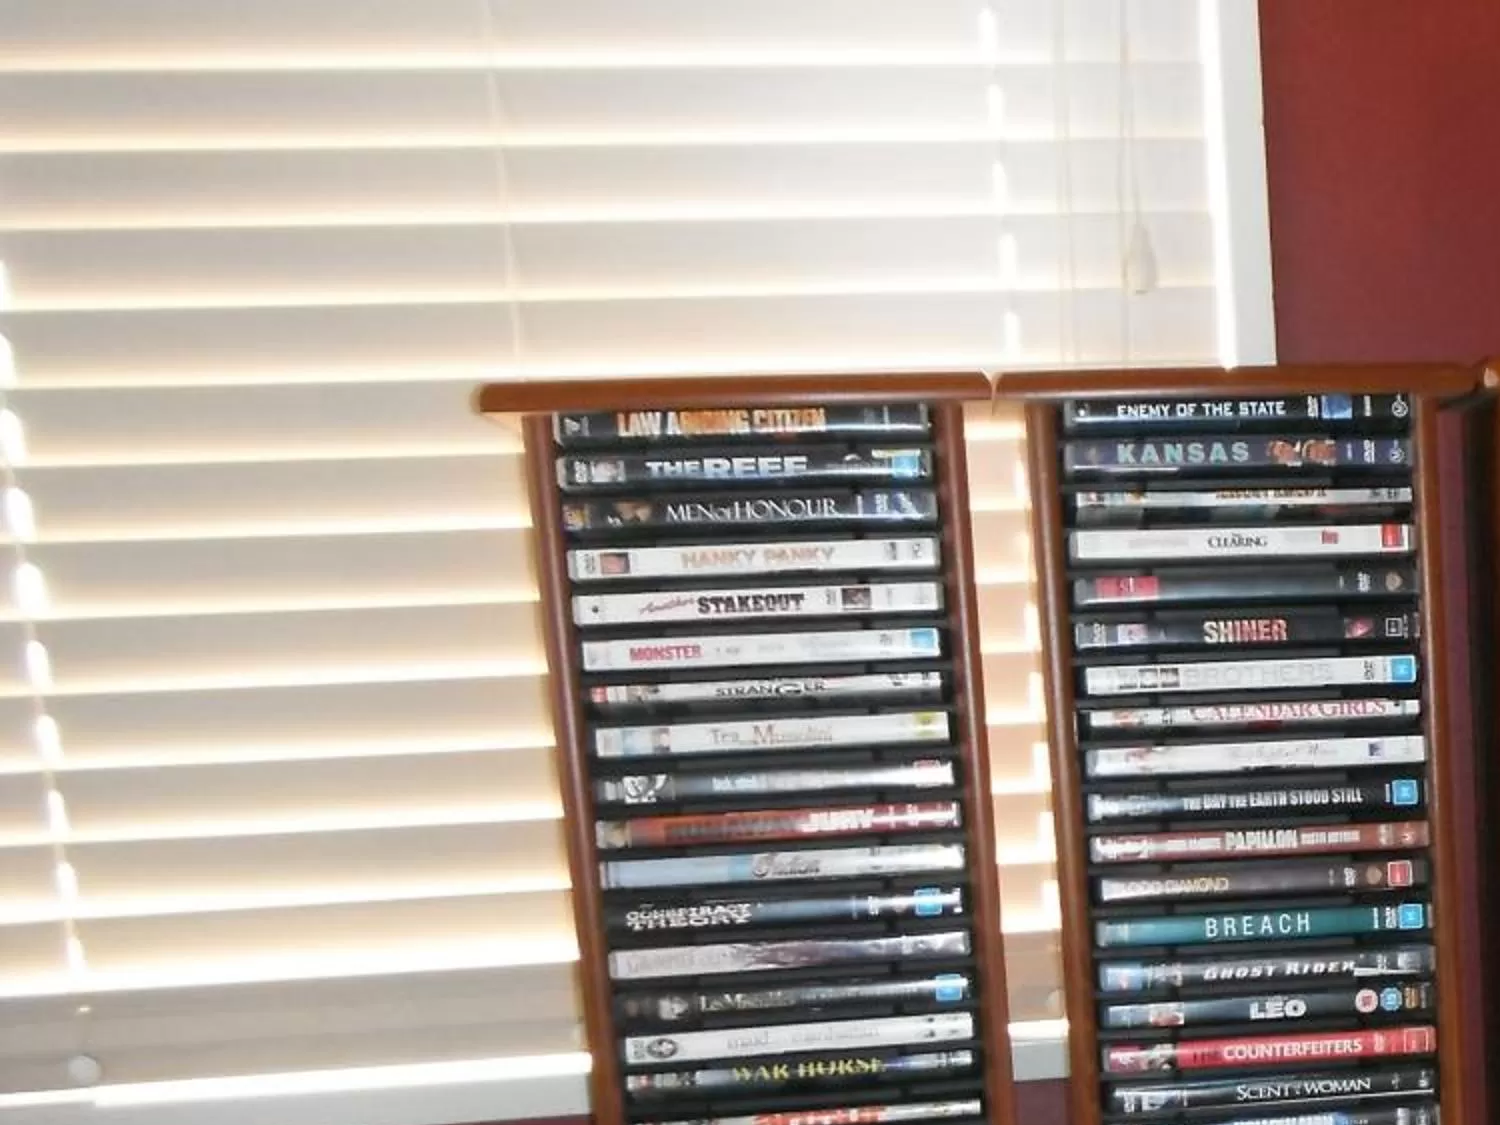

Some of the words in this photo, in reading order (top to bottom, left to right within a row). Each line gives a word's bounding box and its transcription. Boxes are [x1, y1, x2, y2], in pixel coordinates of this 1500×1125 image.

[1117, 404, 1171, 418] ENEMY
[1177, 402, 1195, 417] OF
[1201, 402, 1233, 416] THE
[1239, 400, 1287, 416] STATE
[617, 412, 664, 438] LAW
[1117, 441, 1250, 465] KANSAS
[646, 460, 698, 479] THE
[701, 456, 808, 479] REEF
[666, 503, 716, 523] MEN
[735, 498, 838, 520] HONOUR
[1208, 536, 1268, 549] CLEARING
[697, 592, 805, 615] STAKEOUT
[1203, 619, 1288, 645] SHINER
[629, 643, 701, 661] MONSTER
[1331, 787, 1364, 803] STILL
[1205, 912, 1311, 938] BREACH
[1203, 964, 1277, 981] GHOST
[1249, 1000, 1307, 1019] LEO
[1223, 1039, 1363, 1062] COUNTERFEITERS
[1237, 1083, 1291, 1101] SCENT
[1305, 1078, 1371, 1096] WOMAN
